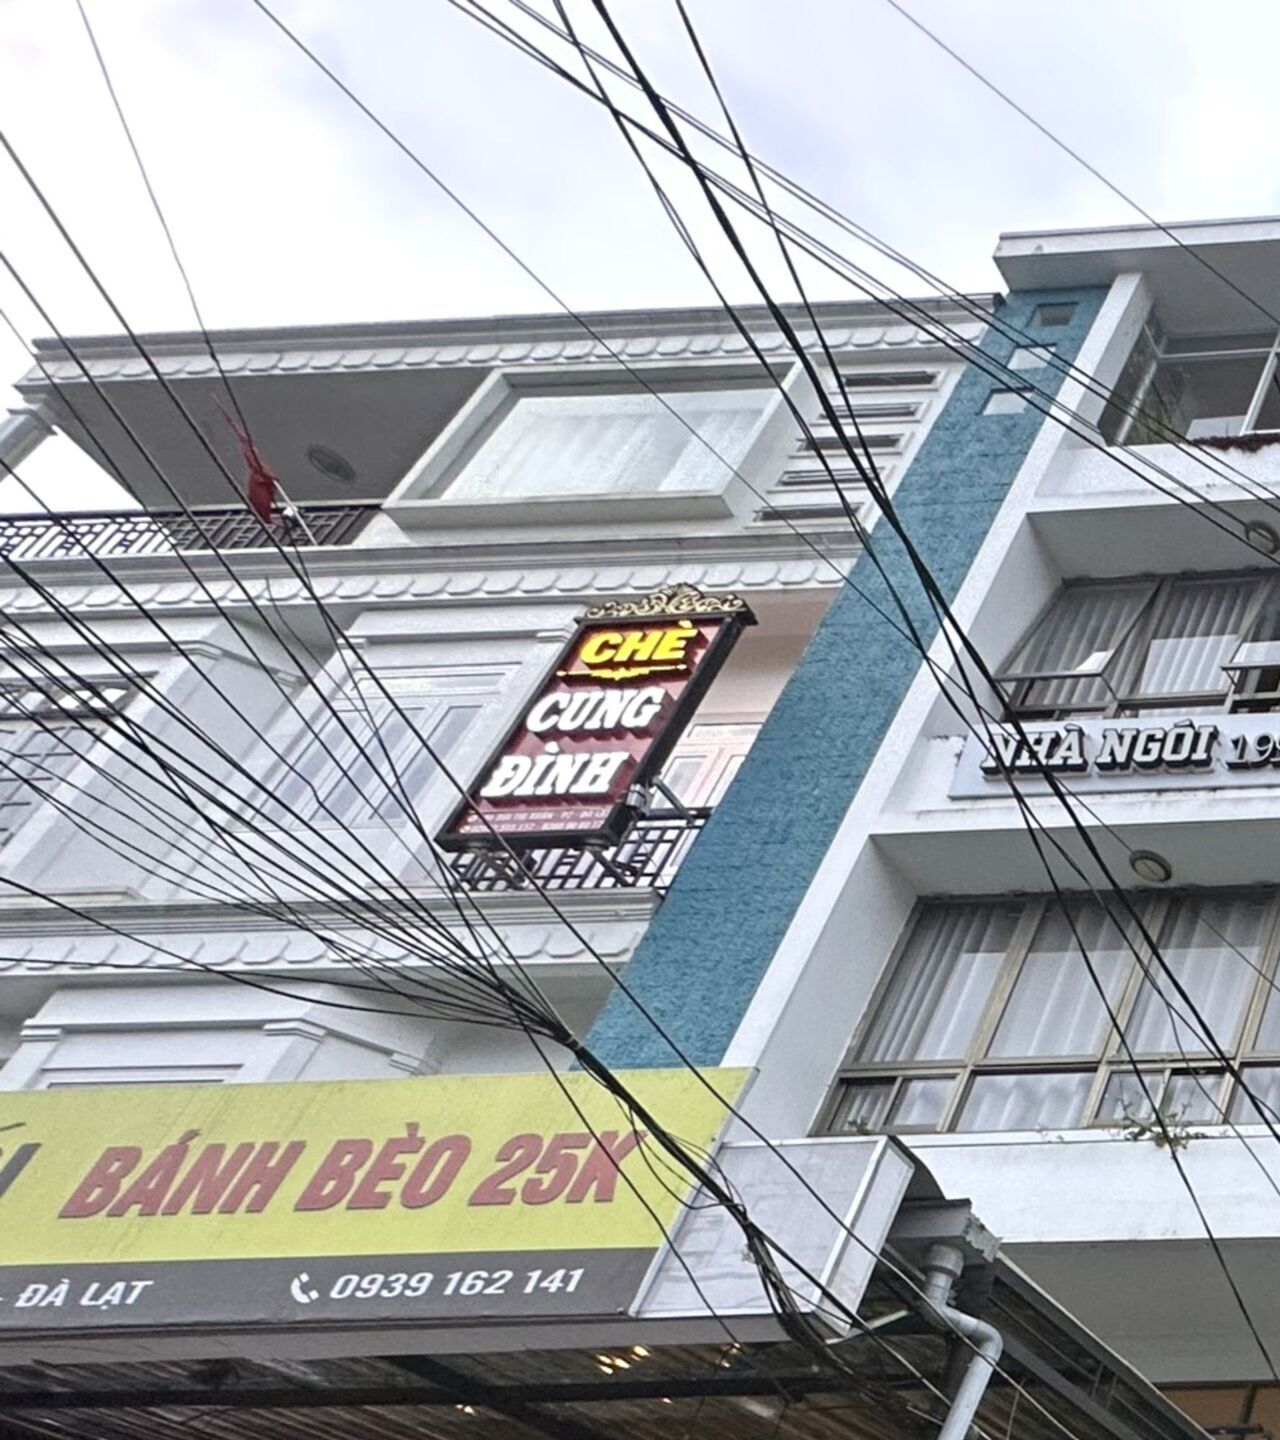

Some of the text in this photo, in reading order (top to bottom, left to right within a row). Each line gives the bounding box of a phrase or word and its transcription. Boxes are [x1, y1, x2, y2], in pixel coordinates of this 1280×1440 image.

[580, 619, 699, 664] CHÈ
[526, 687, 666, 732] CUNG
[982, 722, 1088, 773] NHÀ
[1096, 719, 1218, 772] NGÓI
[480, 741, 632, 797] ĐÌNH
[57, 1129, 308, 1220] BÁNH
[294, 1122, 473, 1212] BÈO
[467, 1129, 648, 1208] 25K
[15, 1279, 155, 1311] ĐÀ LẠT
[329, 1268, 585, 1302] 0939 162 141
